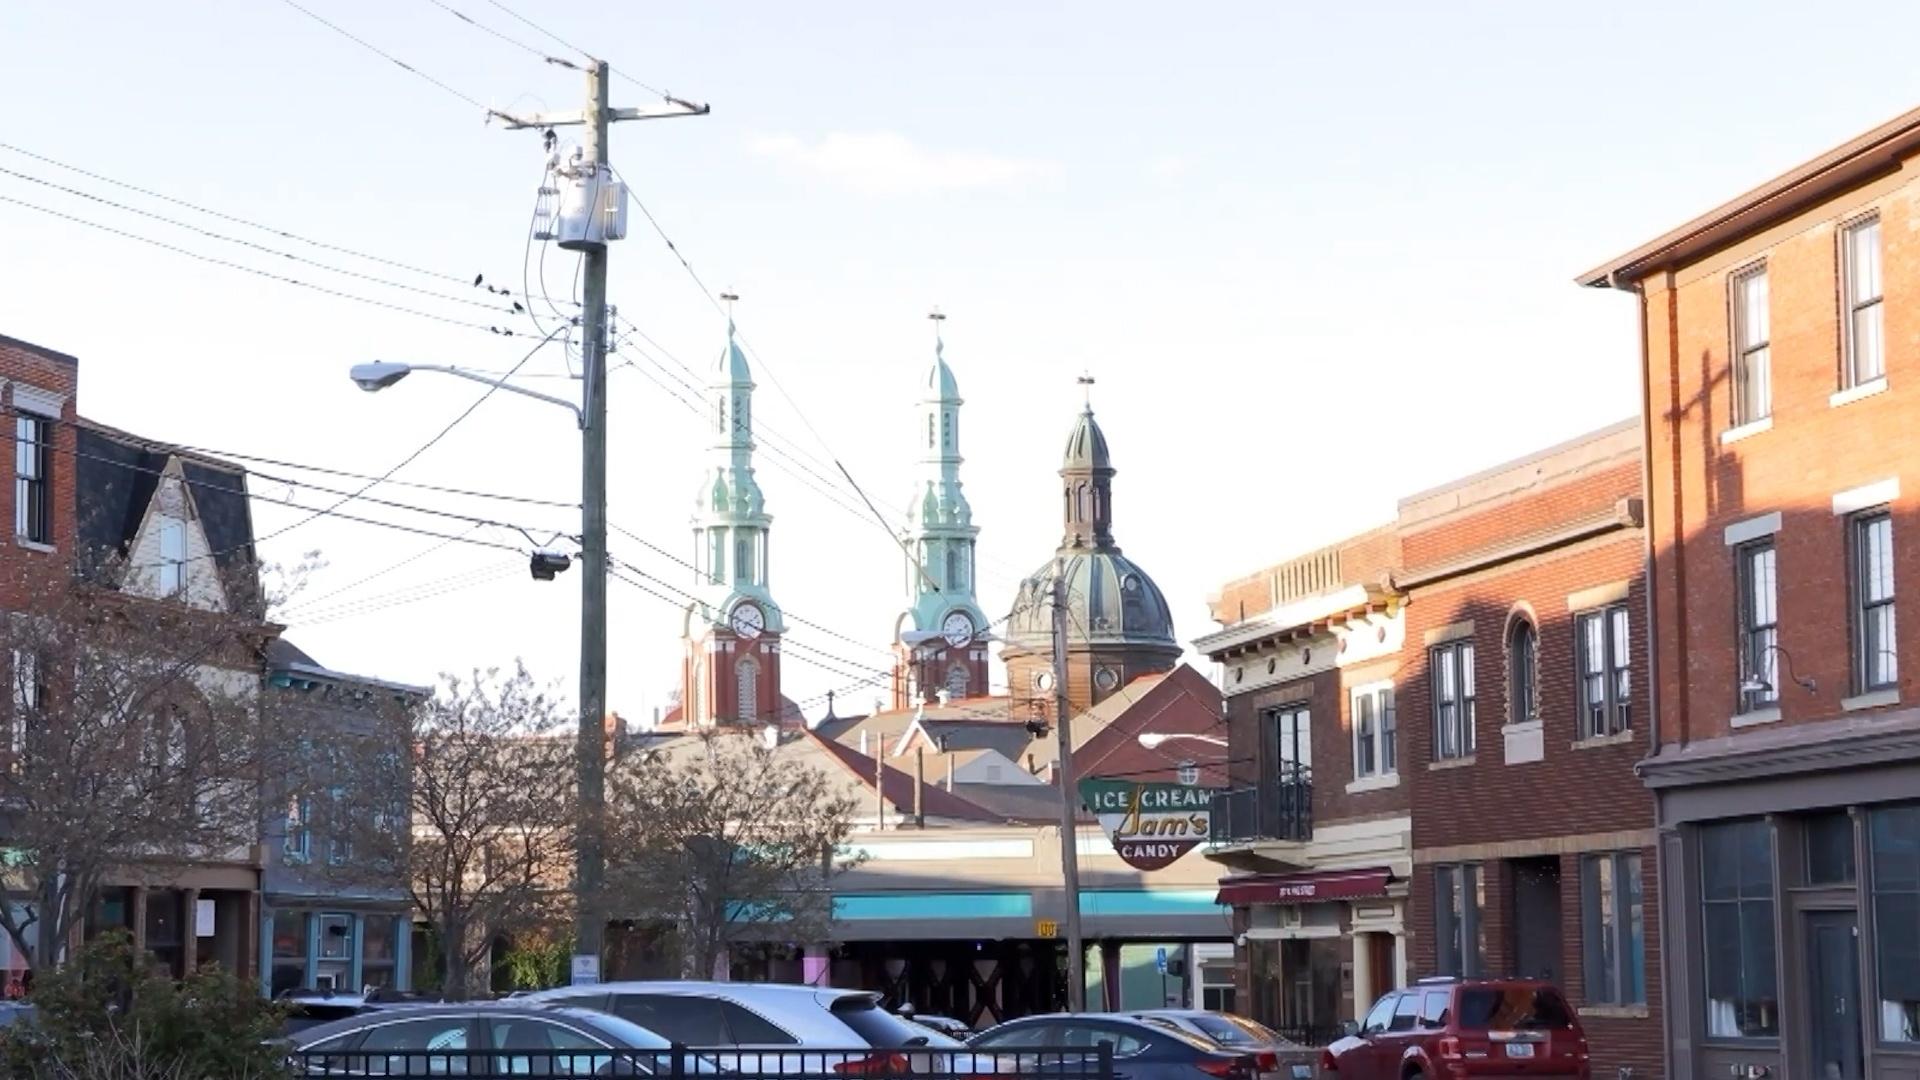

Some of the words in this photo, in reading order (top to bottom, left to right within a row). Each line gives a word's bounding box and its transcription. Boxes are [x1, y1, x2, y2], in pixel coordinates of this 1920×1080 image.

[1094, 791, 1128, 808] ICE
[1141, 789, 1215, 808] CREAM
[1121, 844, 1180, 858] CANDY
